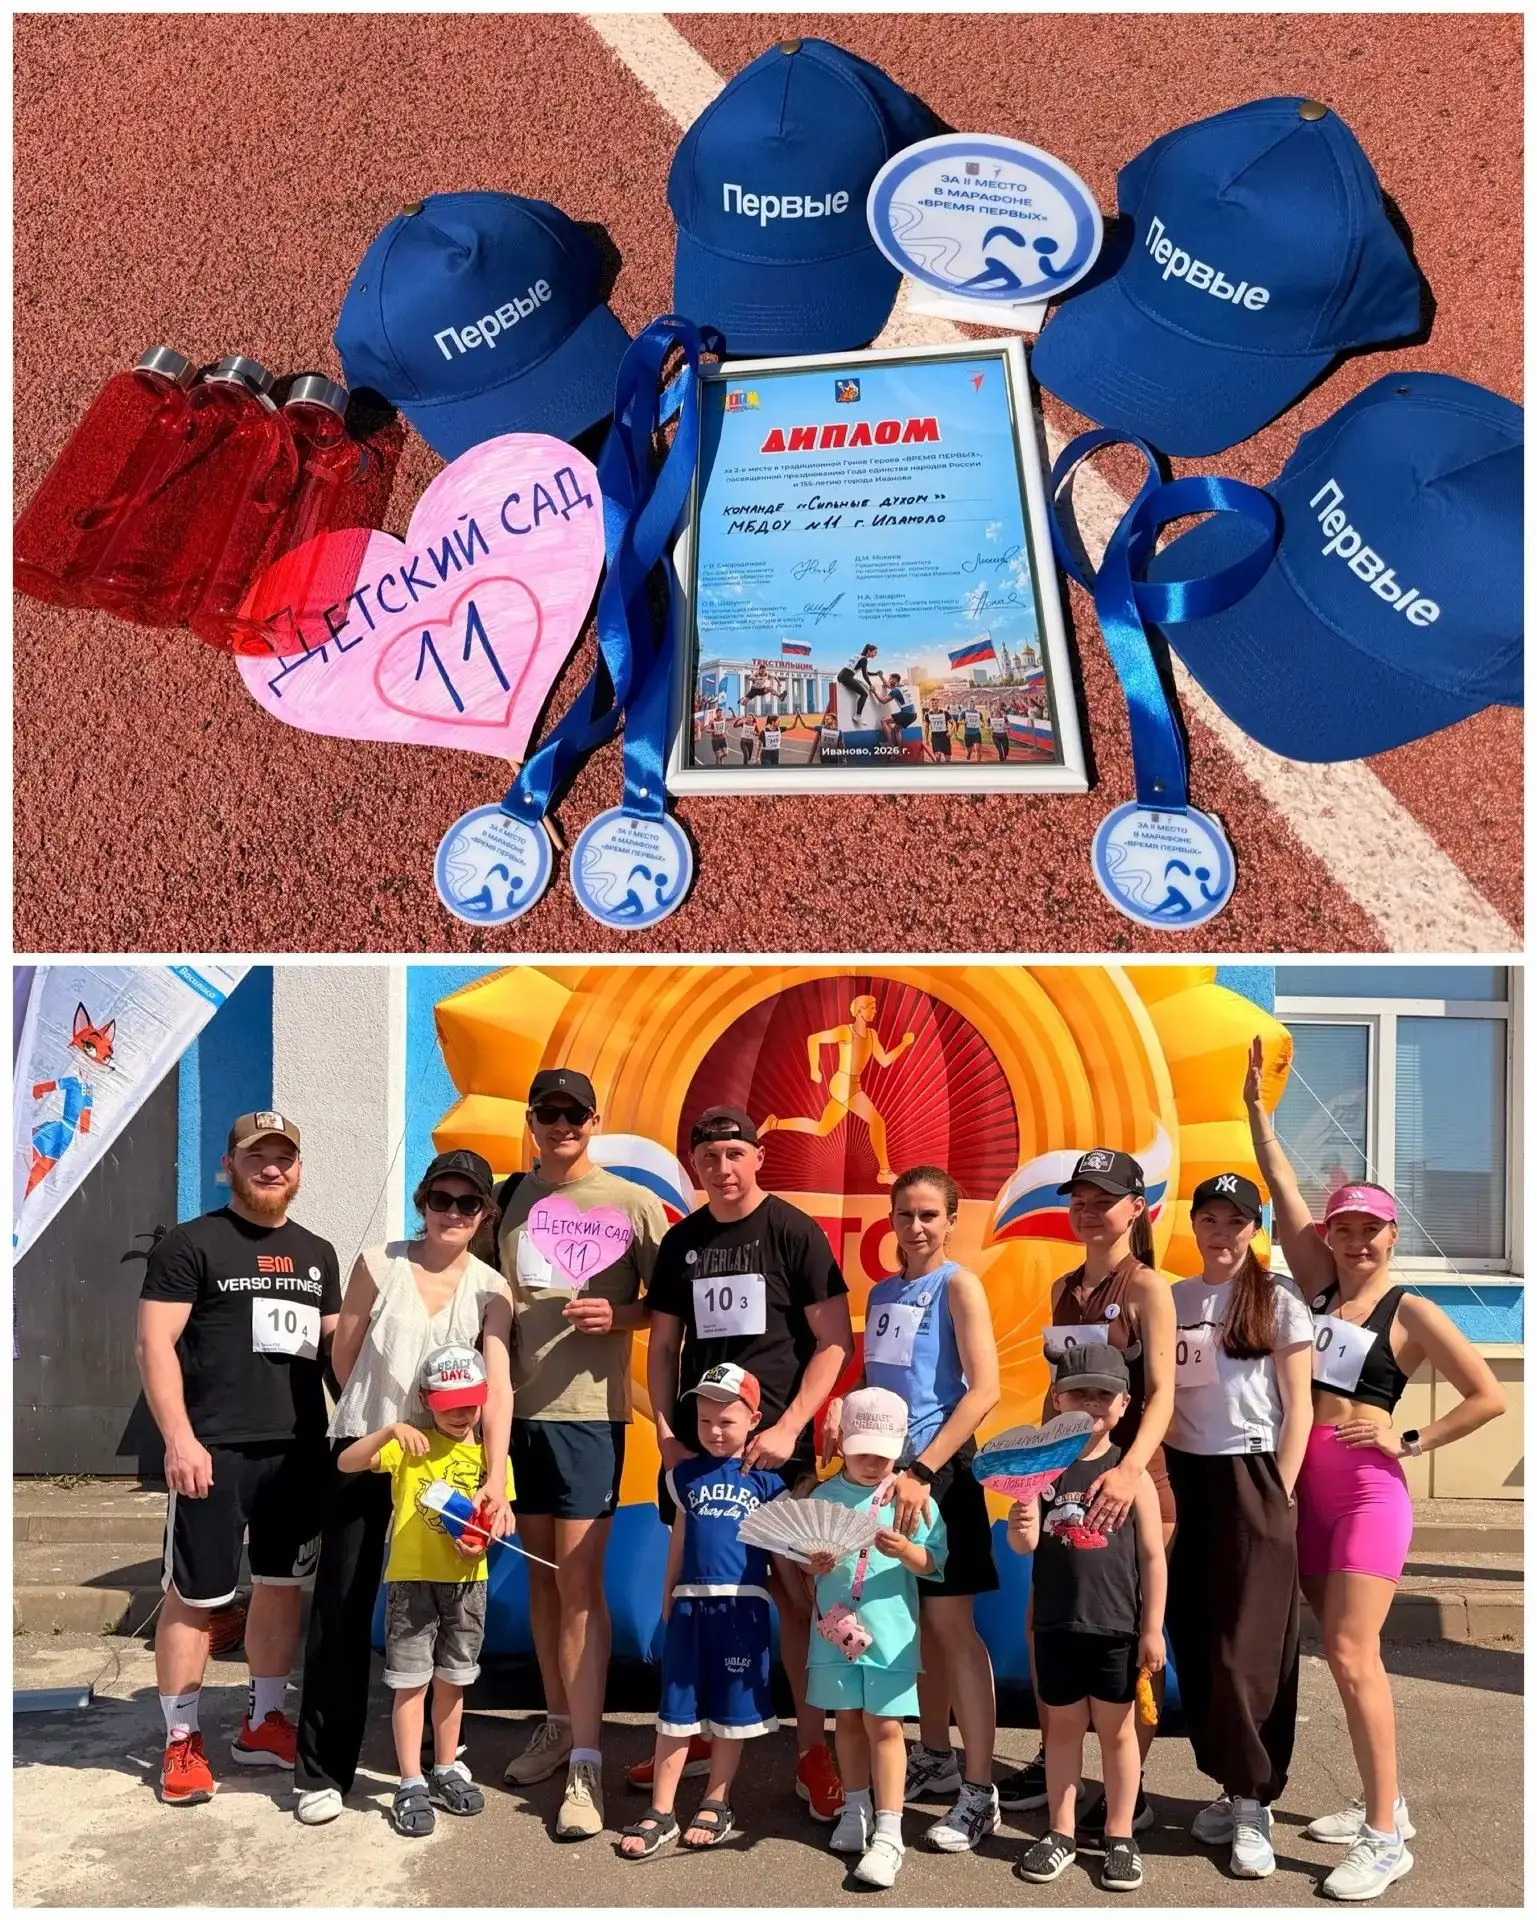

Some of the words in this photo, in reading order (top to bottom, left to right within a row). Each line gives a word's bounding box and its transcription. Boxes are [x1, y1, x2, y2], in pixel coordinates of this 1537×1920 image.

[941, 174, 961, 185] ЗА
[963, 177, 971, 185] II
[974, 178, 1027, 192] МЕСТО
[723, 182, 849, 227] Первые
[934, 187, 943, 196] В
[947, 188, 1033, 207] МАРАФОНЕ
[917, 199, 975, 213] «ВРЕМЯ
[979, 205, 1048, 222] ПЕРВЫХ»
[1145, 215, 1270, 311] Первые
[434, 279, 552, 361] Первые
[760, 416, 942, 453] ДИПЛОМ
[781, 462, 841, 472] традиционной
[870, 458, 900, 466] Героев
[901, 454, 936, 462] «ВРЕМЯ
[783, 470, 845, 479] празднованию
[868, 466, 909, 474] единства
[910, 463, 947, 471] народов
[843, 477, 873, 485] города
[727, 519, 791, 535] МБДОУ
[1309, 478, 1440, 626] Первые
[267, 514, 490, 699] ДЕТСКИЙ
[500, 467, 594, 535] САД
[415, 600, 510, 712] 11
[752, 658, 813, 671] ТЕКСТИЛЬЩИК
[821, 747, 872, 757] Иваново,
[874, 746, 900, 755] 2026
[902, 747, 911, 755] г.
[633, 830, 659, 842] МЕСТО
[1142, 832, 1191, 844] МАРАФОНЕ
[1157, 825, 1187, 834] МЕСТО
[618, 837, 660, 850] МАРАФОНЕ
[1124, 840, 1158, 850] «ВРЕМЯ
[1215, 1175, 1238, 1193] NY
[564, 1243, 588, 1271] 11
[812, 1216, 901, 1283] ТО
[217, 1277, 271, 1292] VERSO
[275, 1278, 322, 1296] FITNESS
[704, 1286, 733, 1312] 10
[740, 1296, 748, 1309] 3
[268, 1308, 297, 1334] 10
[302, 1325, 308, 1337] 4
[876, 1313, 890, 1337] 9
[894, 1325, 900, 1338] 1
[1176, 1340, 1188, 1365] 0
[1194, 1349, 1201, 1363] 2
[1315, 1326, 1333, 1352] 0
[1339, 1345, 1346, 1358] 1
[688, 1484, 760, 1516] EAGLES
